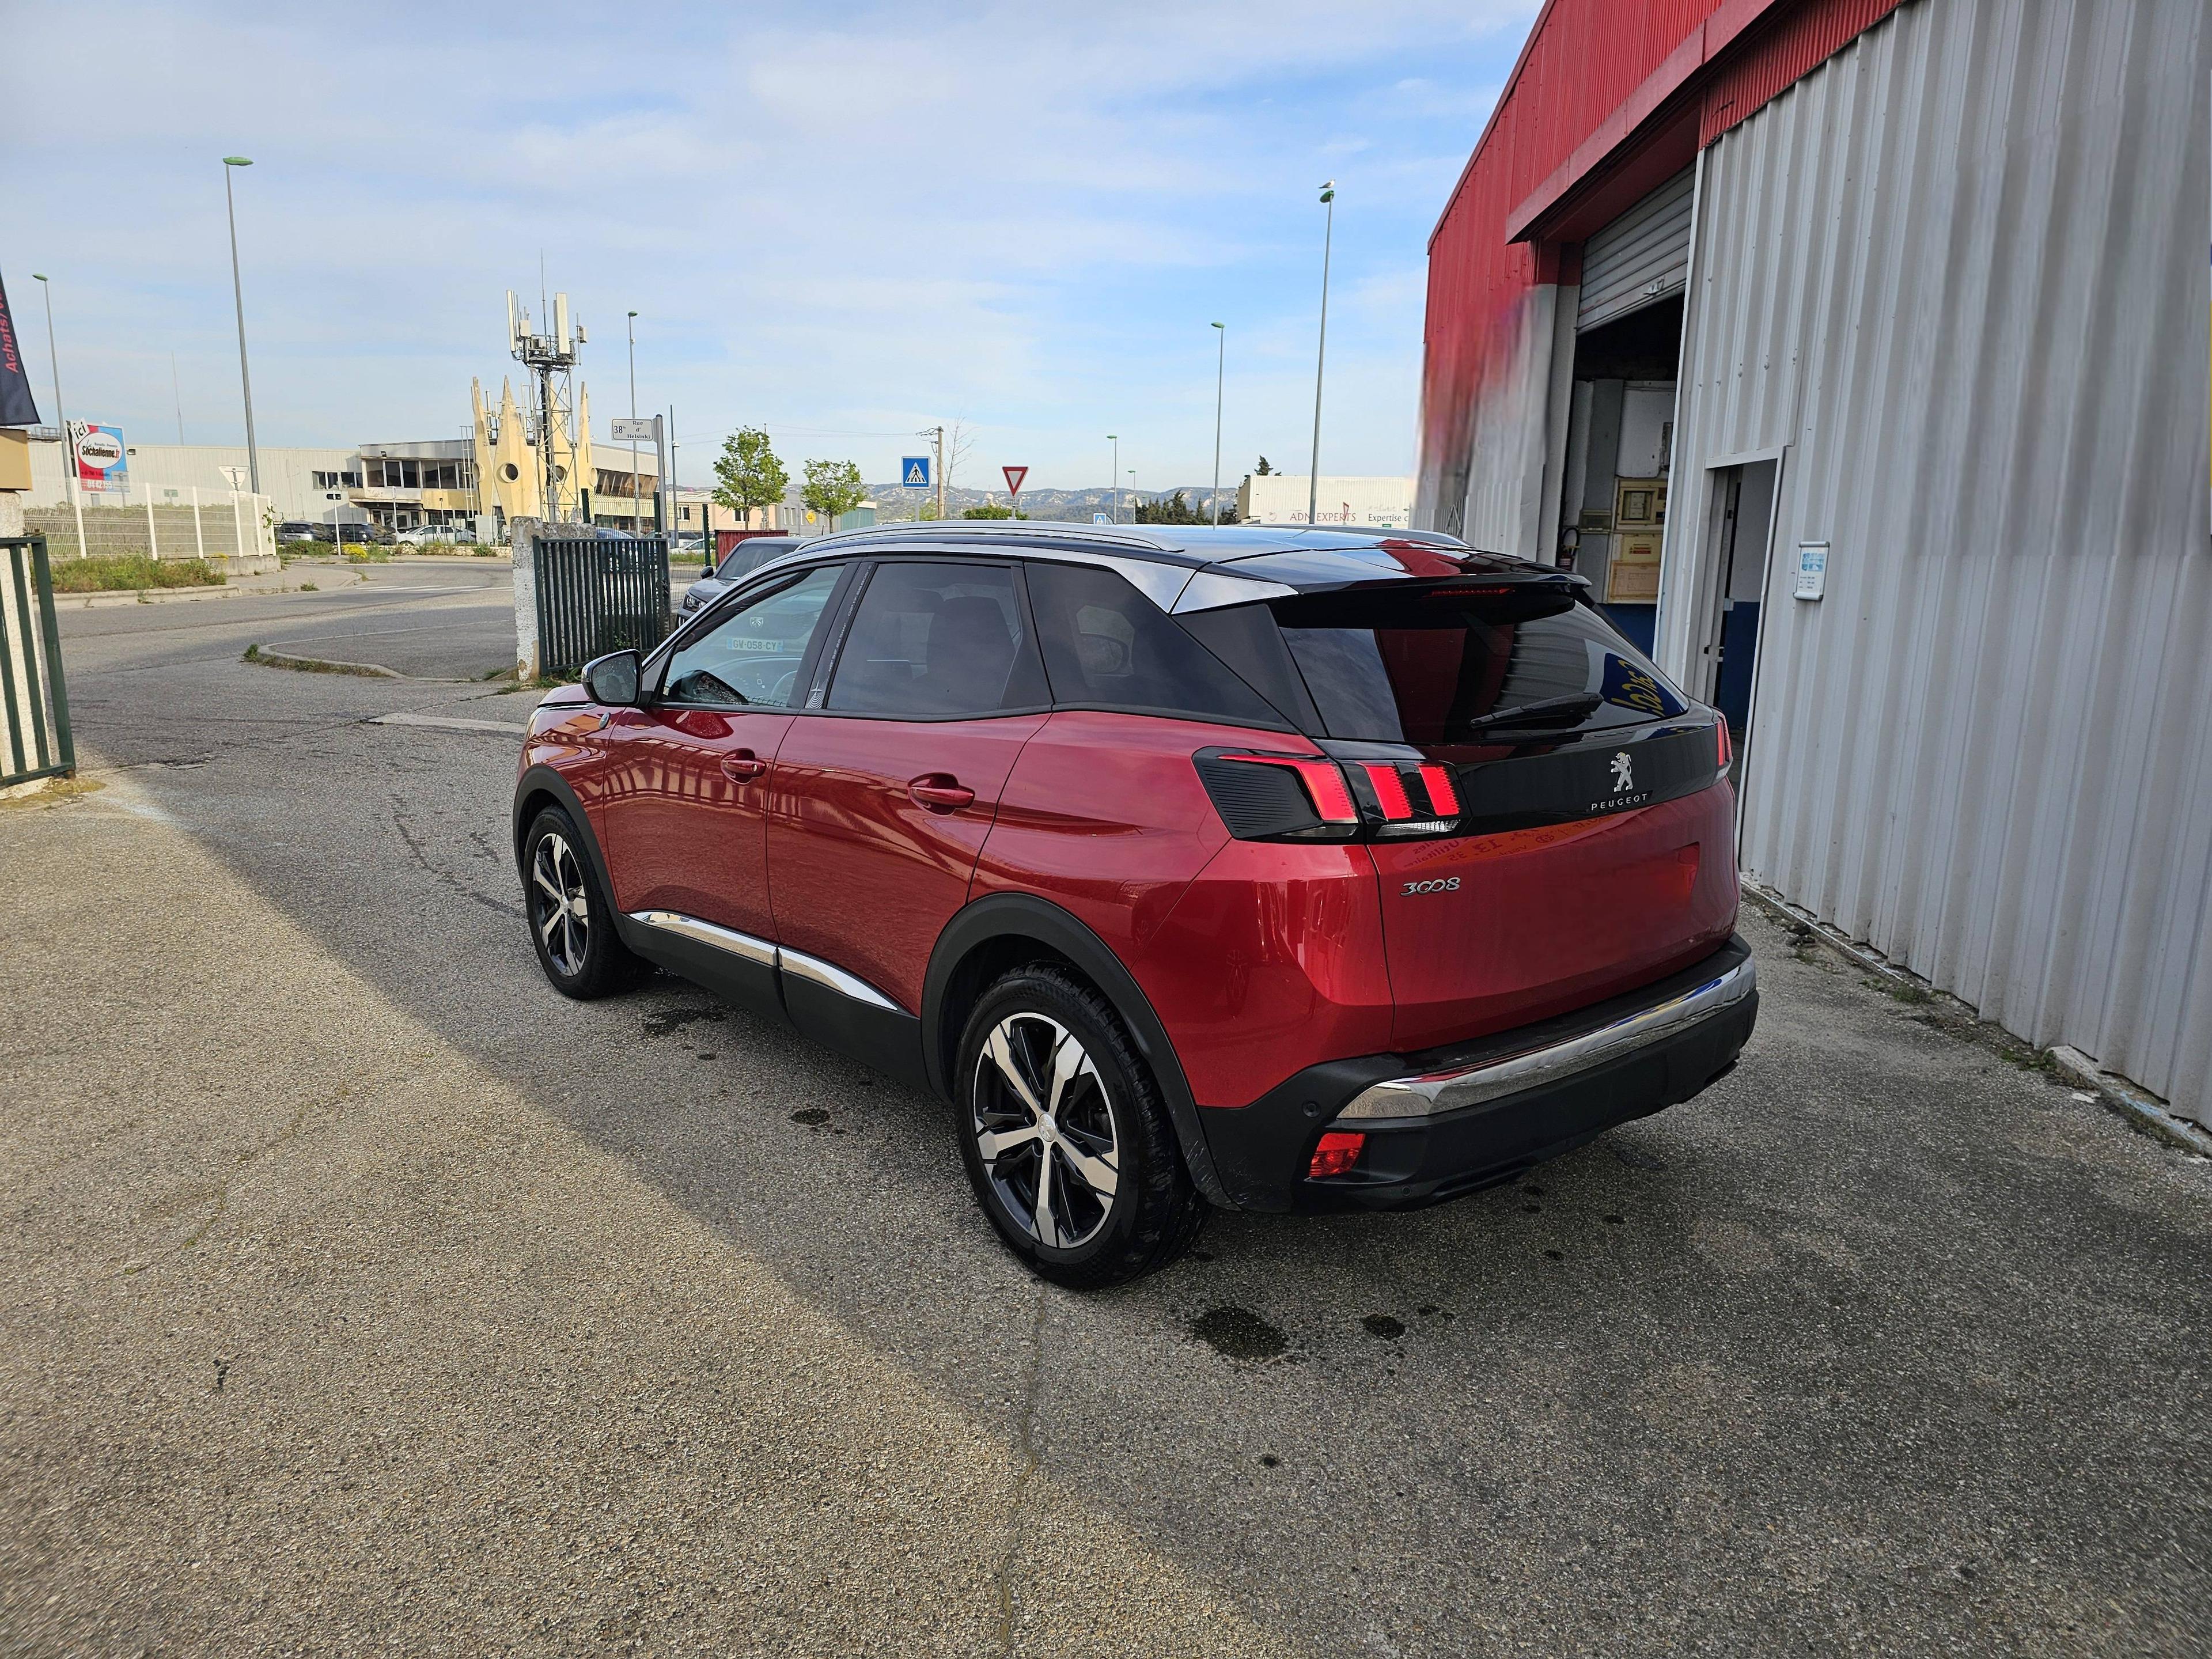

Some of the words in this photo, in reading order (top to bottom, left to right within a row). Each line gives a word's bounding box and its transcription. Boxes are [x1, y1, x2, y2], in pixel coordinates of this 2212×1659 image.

[74, 422, 86, 440] ici
[1317, 513, 1356, 521] EXPERTS
[1368, 513, 1402, 522] Expertise
[1591, 793, 1647, 811] PEUGEOT
[1400, 876, 1461, 897] 3008
